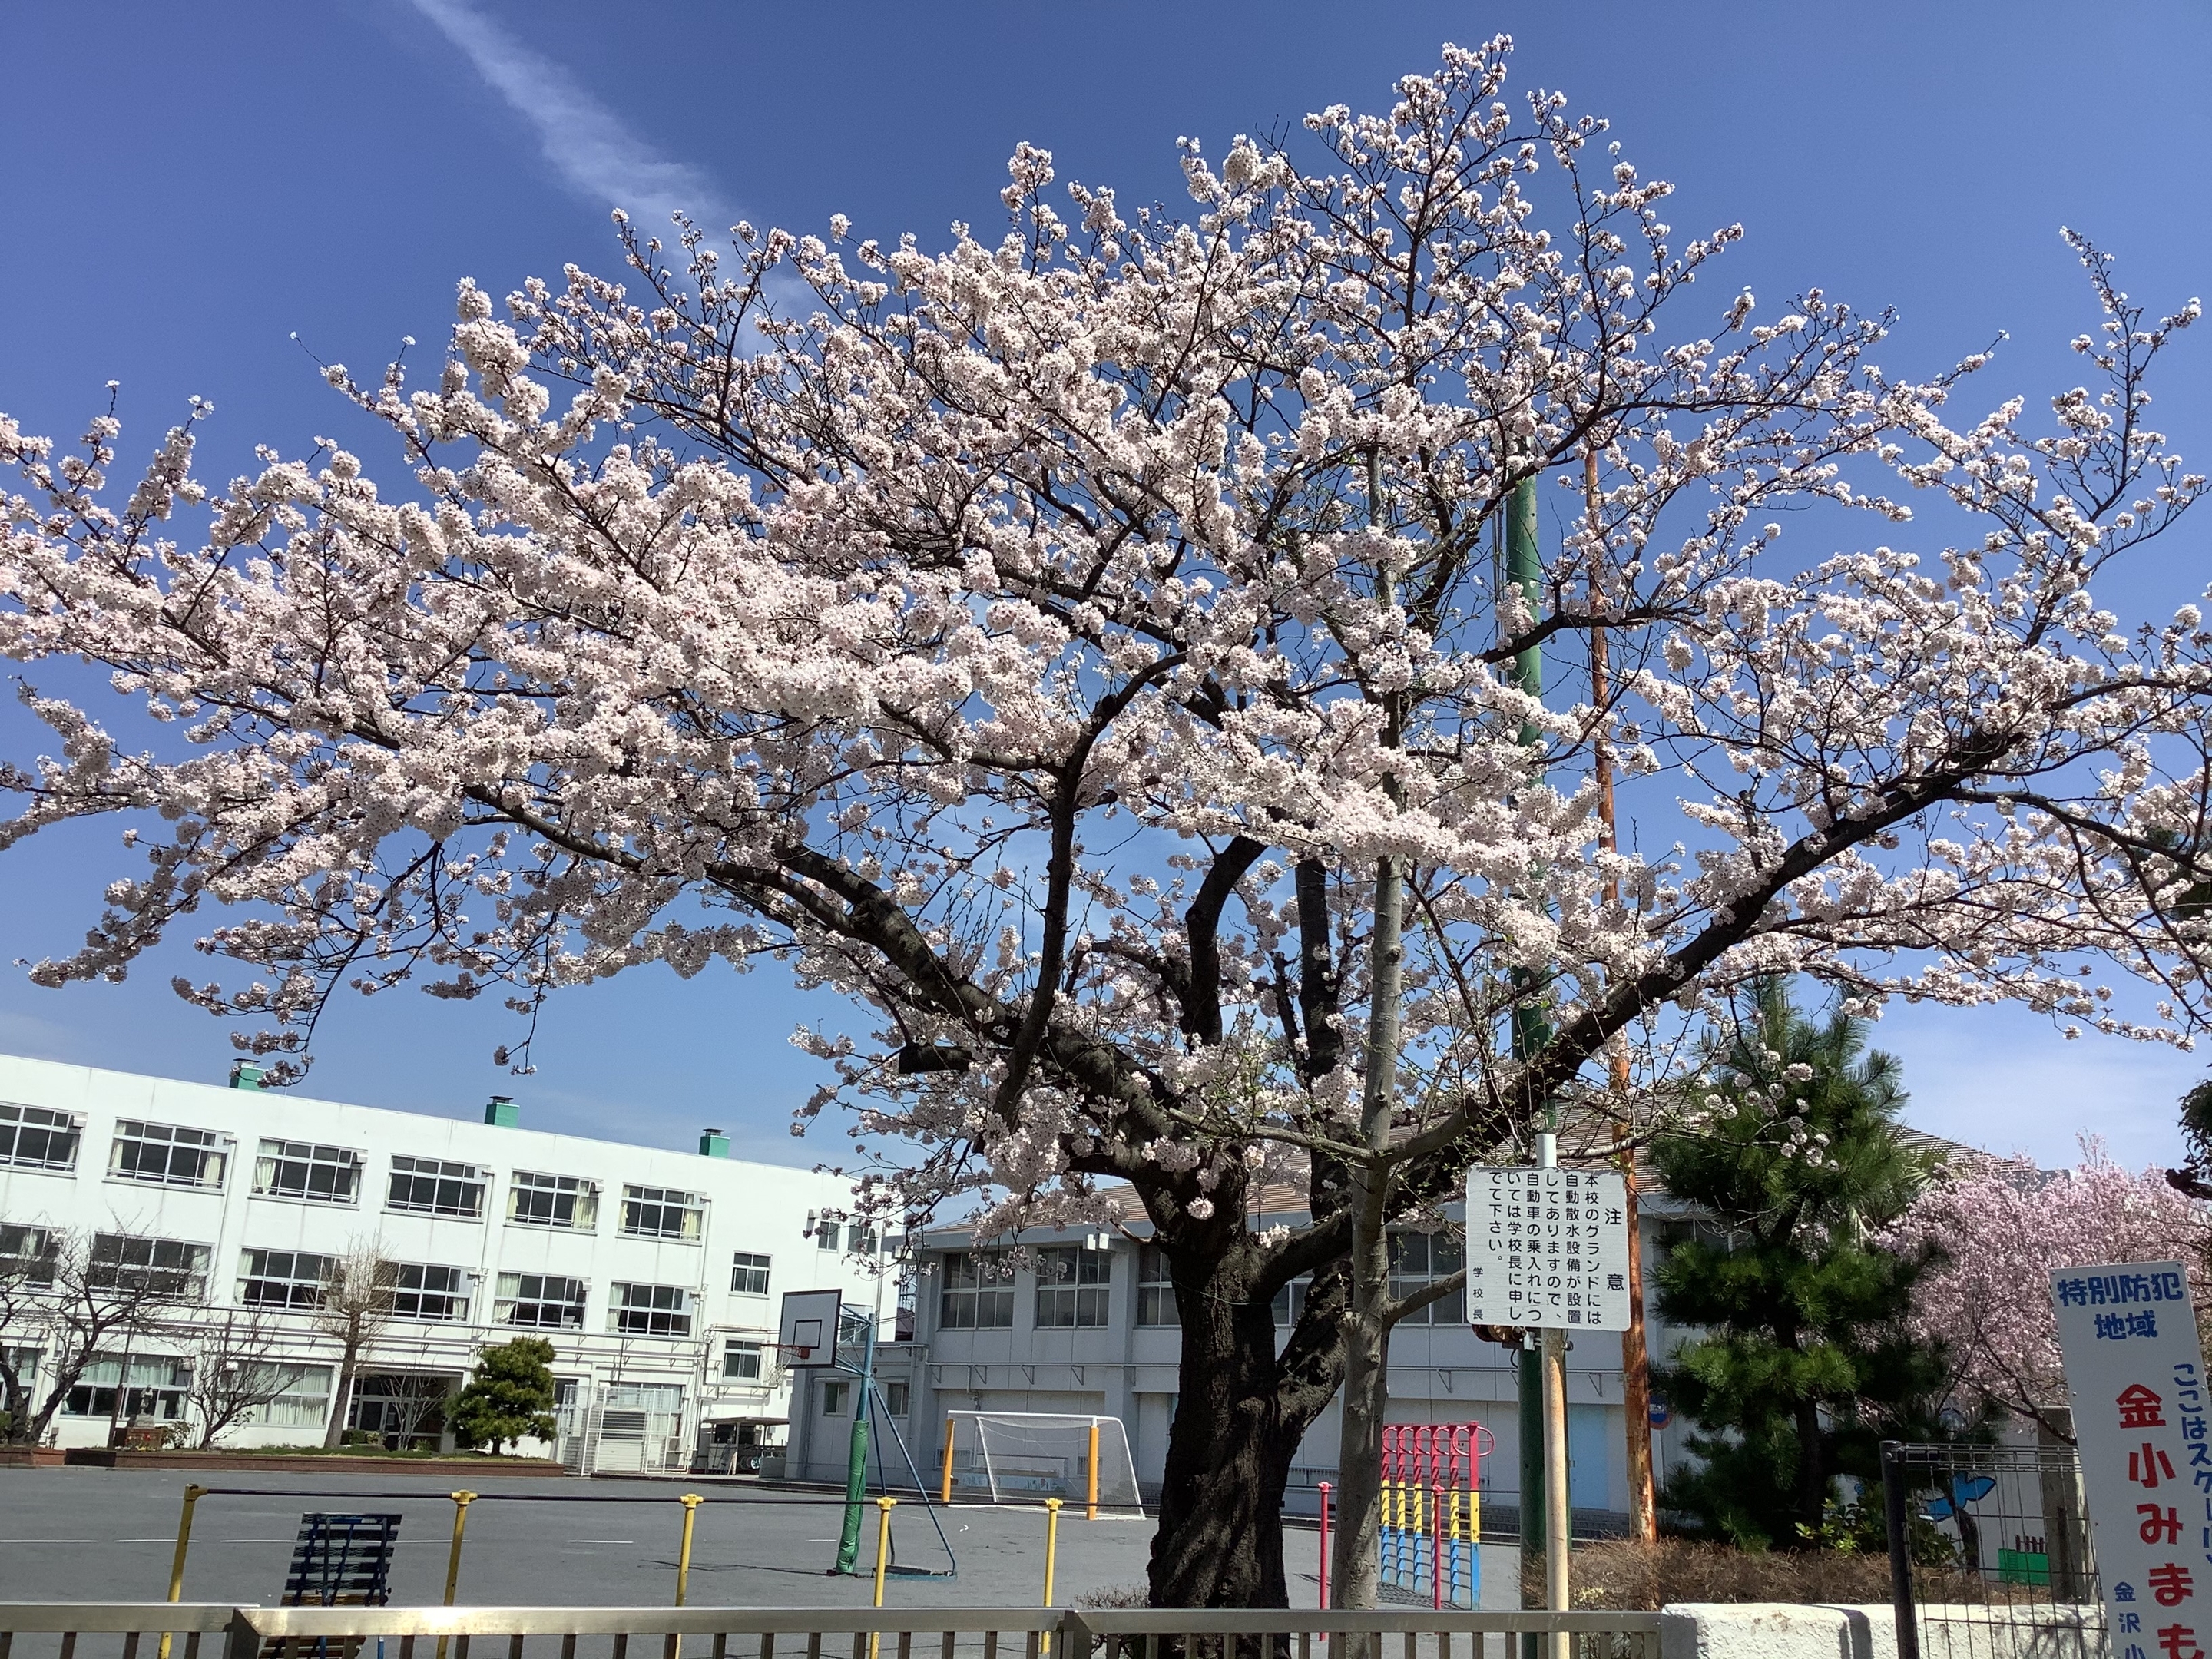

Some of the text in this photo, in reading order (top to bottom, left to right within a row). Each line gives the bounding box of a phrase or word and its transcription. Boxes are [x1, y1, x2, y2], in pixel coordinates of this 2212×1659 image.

[1488, 1171, 1502, 1260] でて下さい。
[1507, 1173, 1522, 1320] いては学校長に申し
[1527, 1174, 1542, 1322] 自動車の乗入れにつ
[1546, 1174, 1561, 1319] してありますので、
[1565, 1174, 1581, 1324] 自動散水設備が設置
[1584, 1174, 1601, 1324] 本校のグランドには
[1604, 1207, 1624, 1291] 注意
[1473, 1267, 1484, 1320] 学校長
[2058, 1272, 2183, 1306] 特別防犯
[2094, 1310, 2157, 1339] 地域
